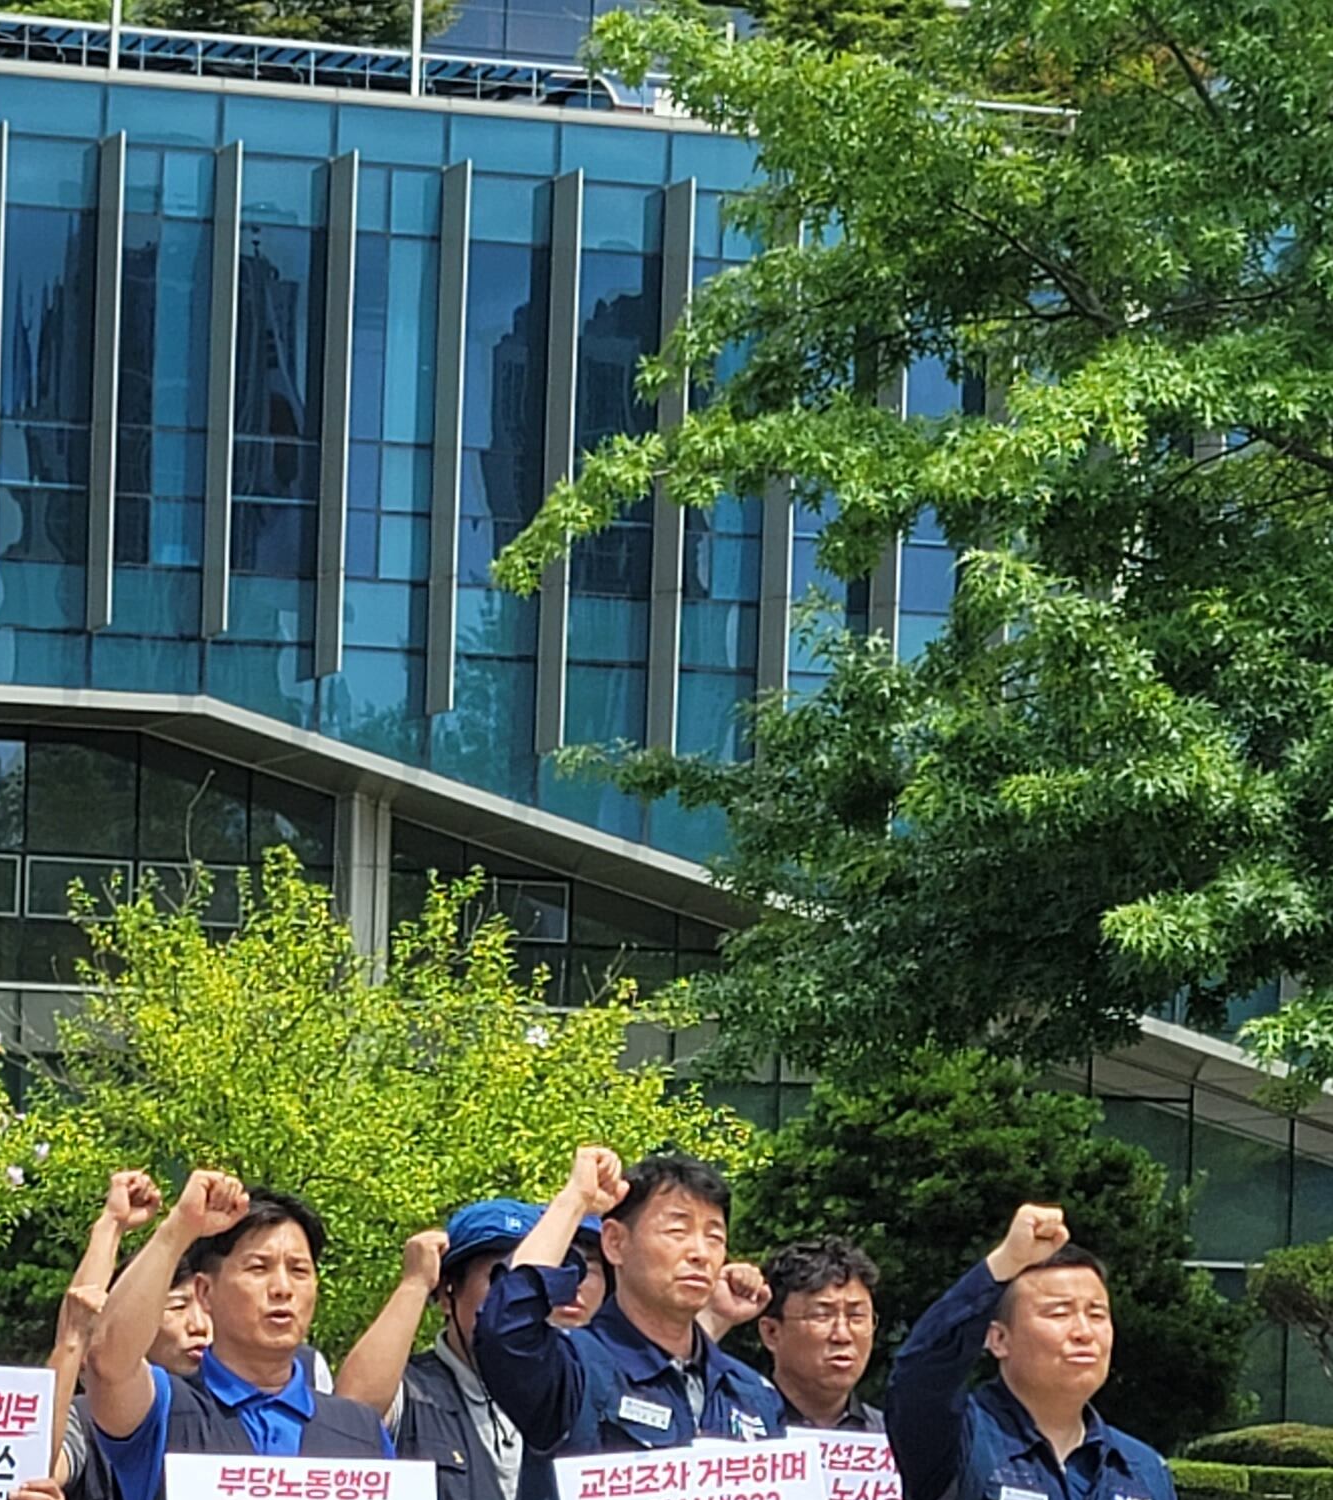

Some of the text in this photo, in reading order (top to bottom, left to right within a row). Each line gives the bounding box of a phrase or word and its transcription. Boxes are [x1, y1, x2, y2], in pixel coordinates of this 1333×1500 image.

[218, 1467, 391, 1500] 부당노동행위
[579, 1451, 807, 1500] 교섭조차 거부하며
